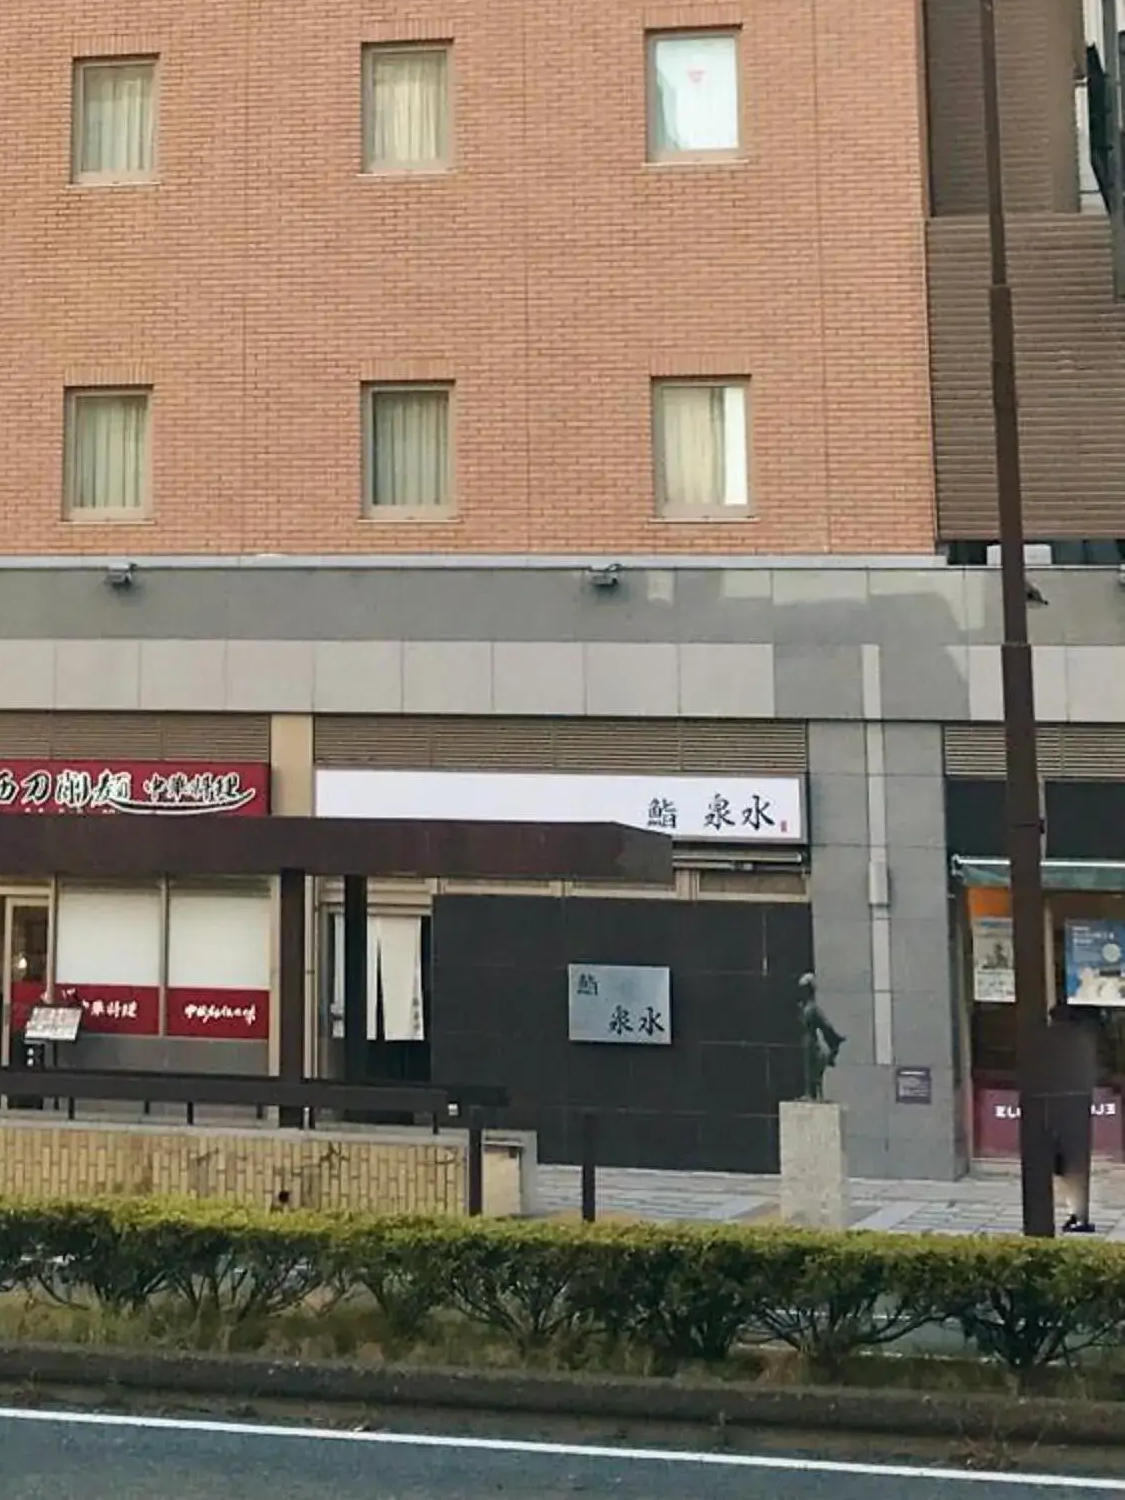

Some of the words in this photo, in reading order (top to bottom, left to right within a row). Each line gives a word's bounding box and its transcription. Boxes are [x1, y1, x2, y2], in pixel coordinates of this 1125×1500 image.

[647, 798, 678, 829] 鮨
[703, 793, 776, 831] 泉水
[608, 1004, 666, 1037] 泉水
